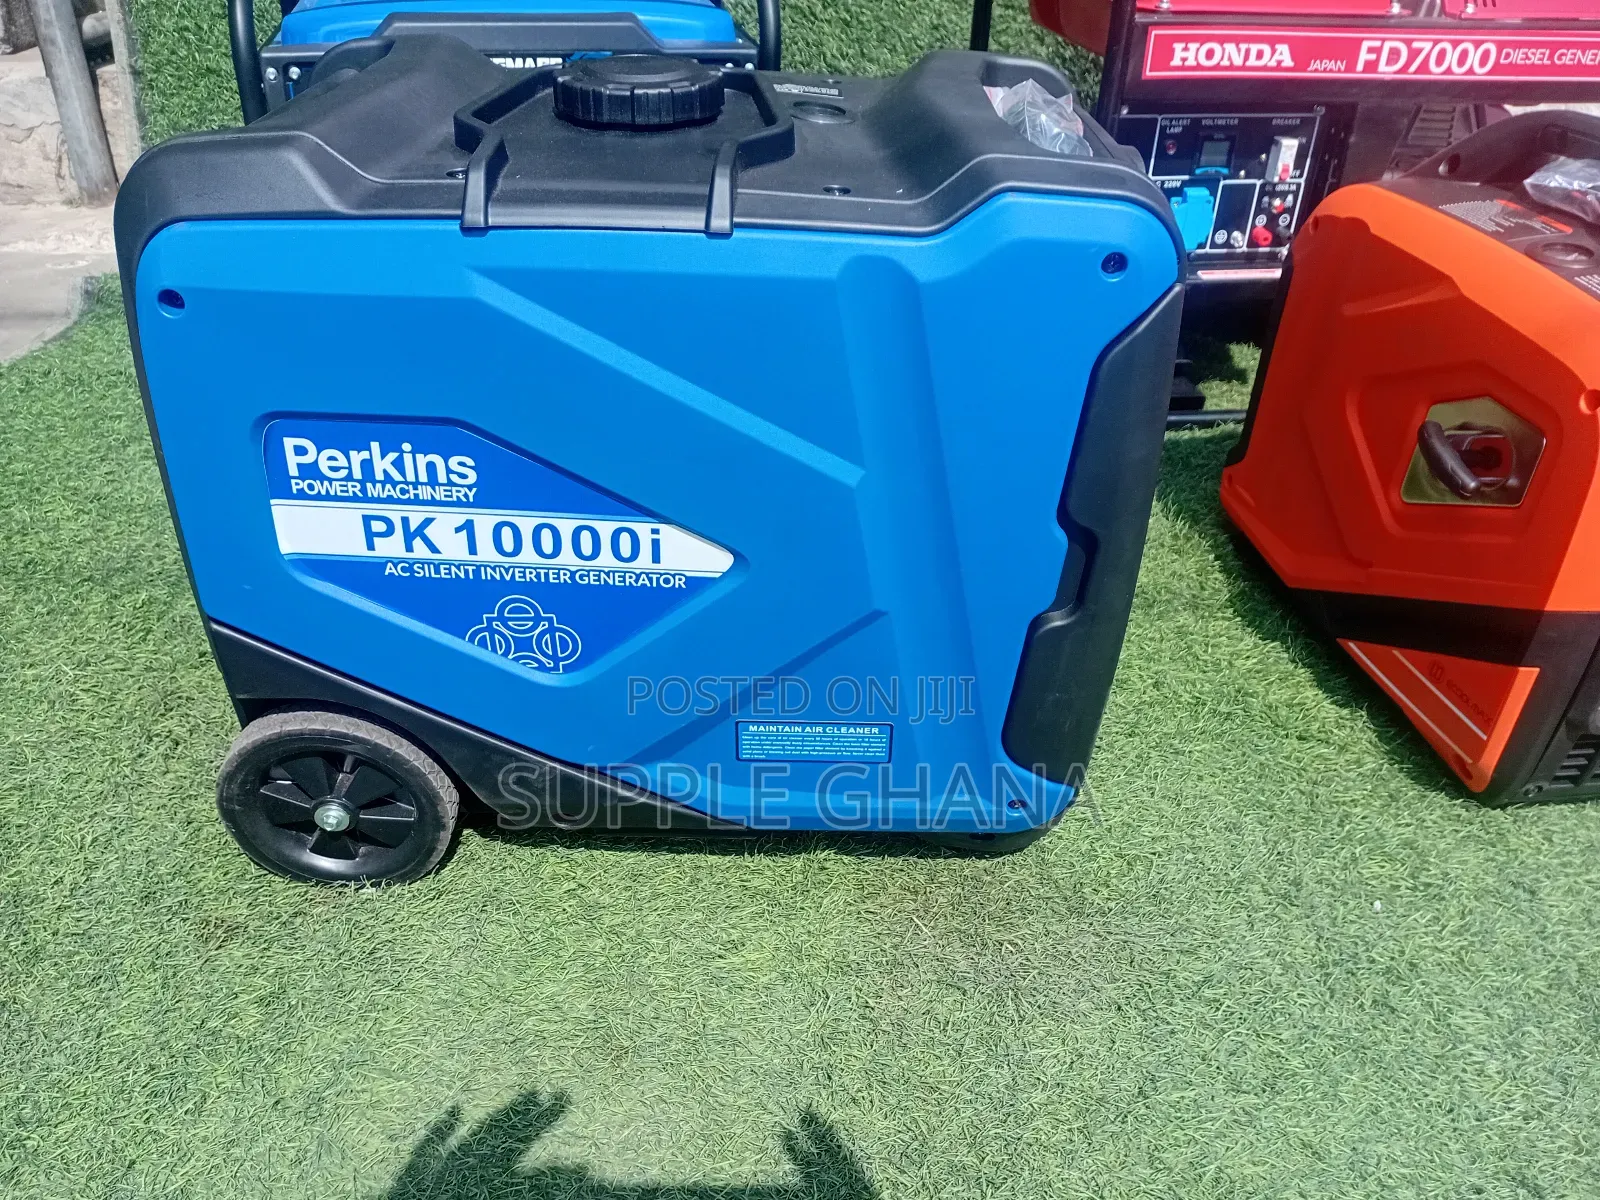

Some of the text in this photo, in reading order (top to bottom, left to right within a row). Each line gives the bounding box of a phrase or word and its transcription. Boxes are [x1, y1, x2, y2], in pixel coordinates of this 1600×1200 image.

[1169, 41, 1295, 68] HONDA
[1307, 59, 1347, 72] JAPAN
[1355, 40, 1498, 76] FD7000
[1499, 48, 1551, 65] DIESEL
[1201, 117, 1239, 127] VOLTMETER
[1272, 117, 1301, 126] BREAKER
[282, 436, 478, 486] Perkins
[291, 478, 477, 503] POWER MACHINERY
[384, 562, 687, 589] AC SILENT INVERTER GENERATOR
[748, 724, 880, 735] MAINTAIN AIR CLEANER
